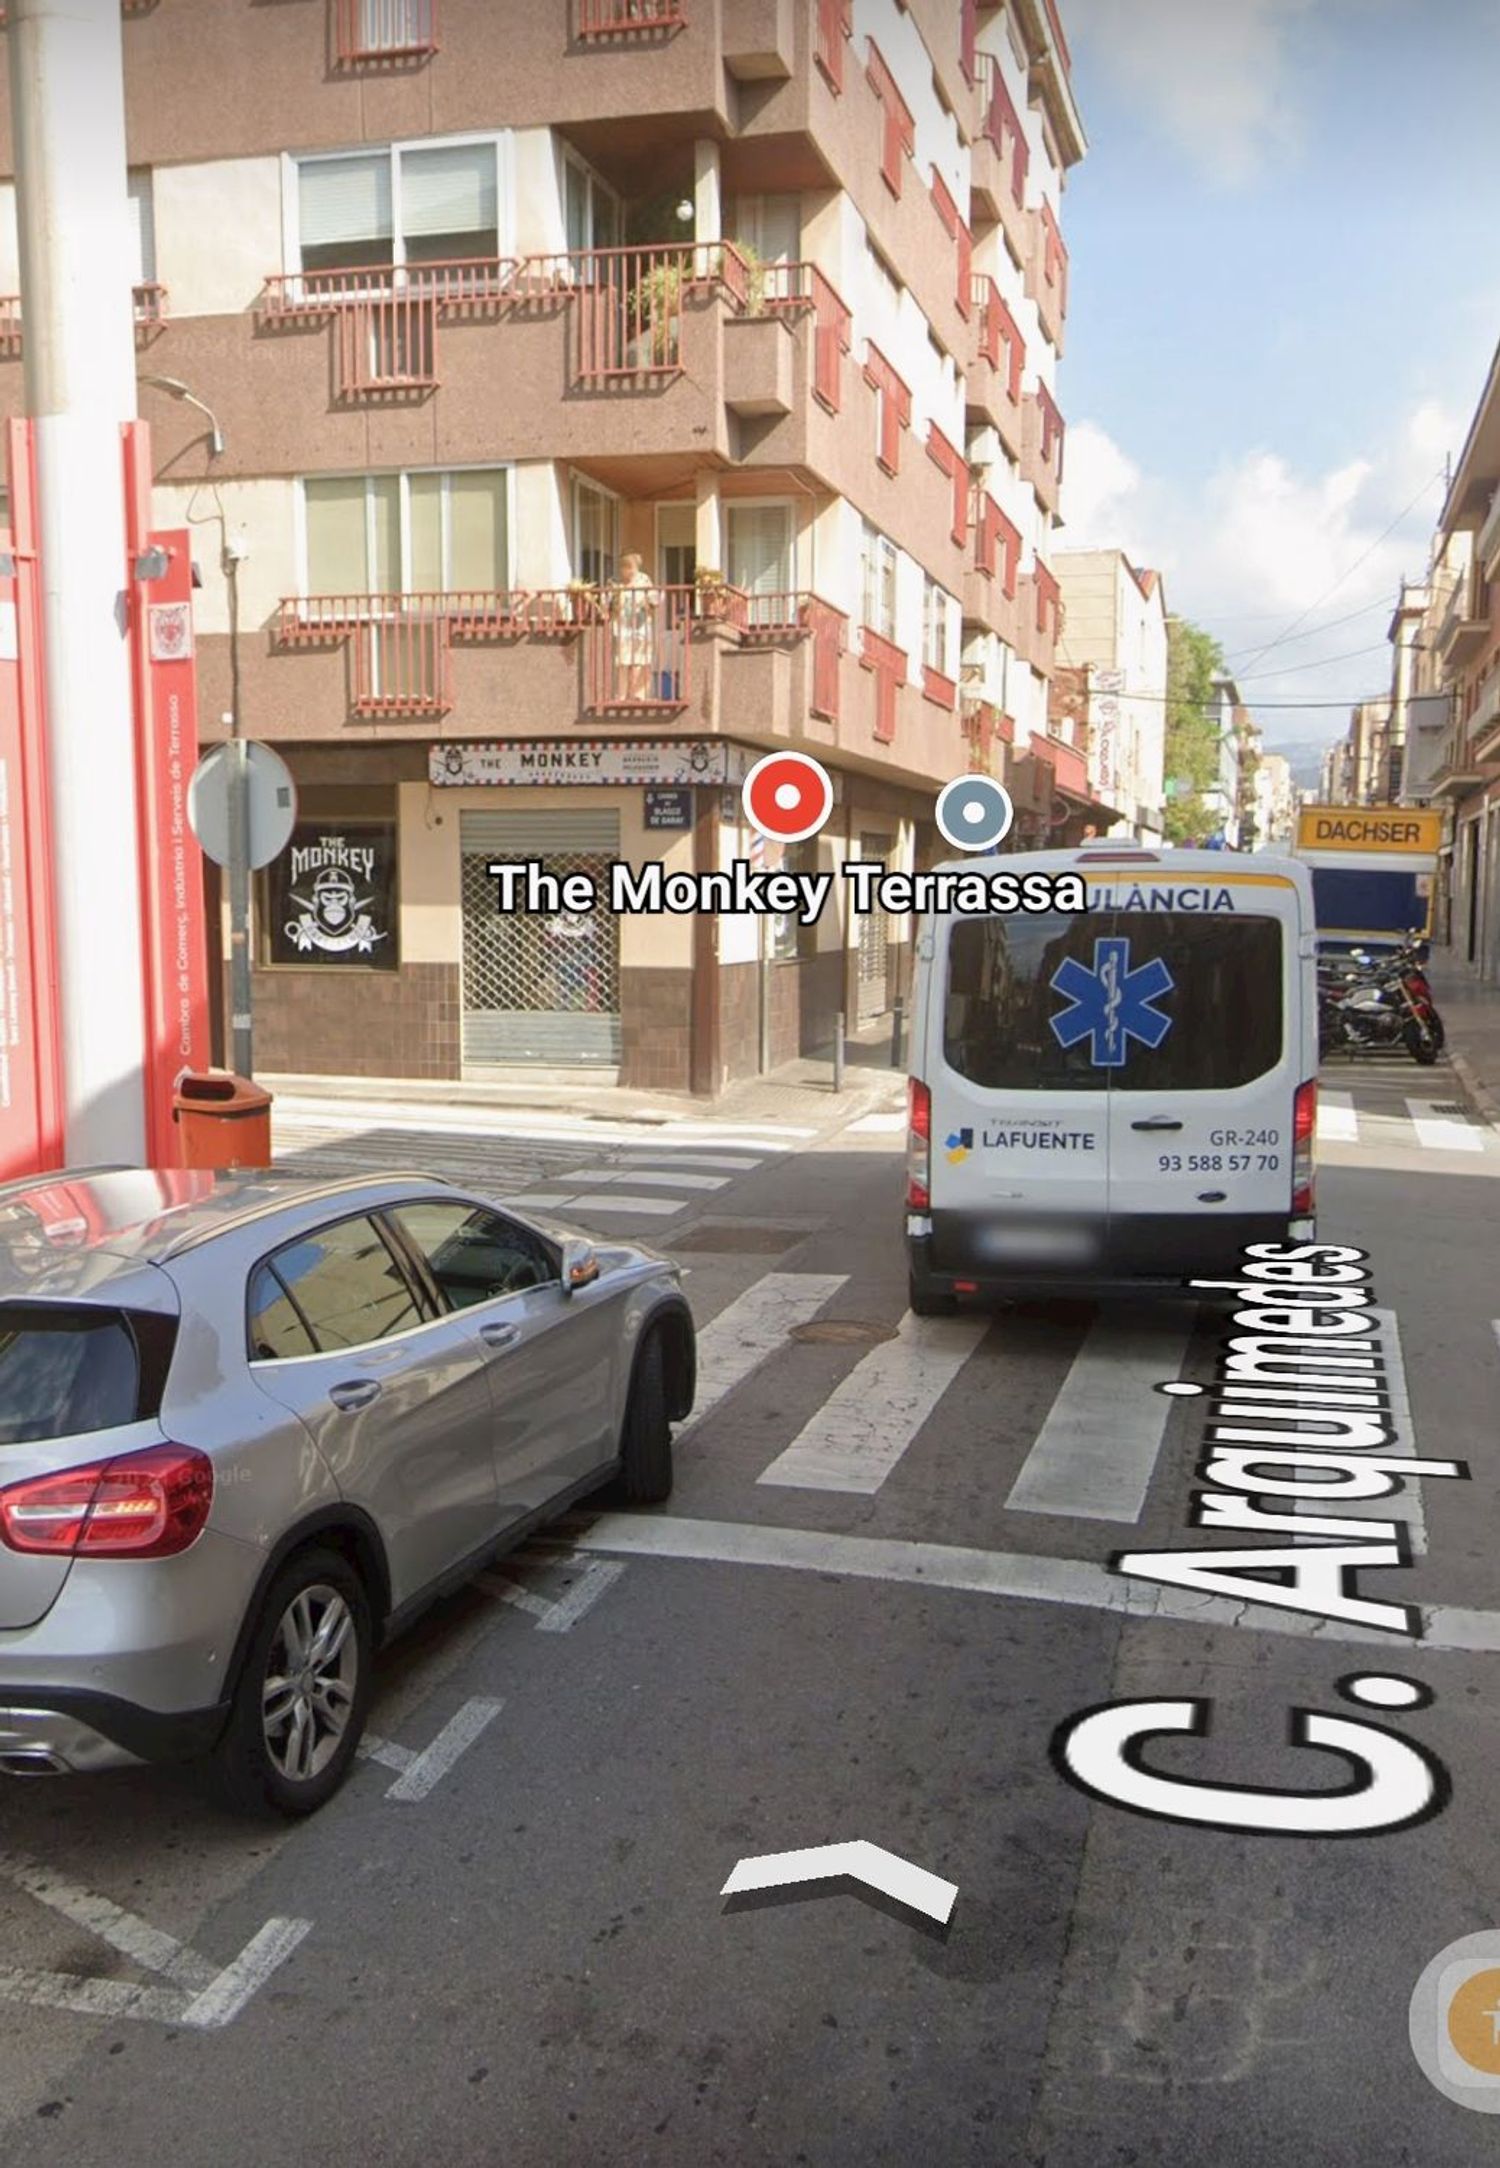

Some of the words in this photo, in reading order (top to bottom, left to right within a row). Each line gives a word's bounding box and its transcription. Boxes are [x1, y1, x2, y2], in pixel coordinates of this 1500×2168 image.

[169, 694, 181, 756] Terrassa
[170, 759, 182, 780] de
[480, 758, 502, 769] THE
[520, 752, 602, 768] MONKEY
[172, 782, 184, 836] Serveis
[319, 836, 346, 848] THE
[1316, 820, 1420, 843] DACHSER
[291, 847, 374, 886] MONKEY
[1086, 883, 1235, 912] ULÀNCIA
[178, 972, 190, 993] de
[179, 997, 192, 1056] Cambra
[983, 1130, 1096, 1150] LAFUENTE
[1210, 1129, 1279, 1147] GR-240
[1159, 1155, 1182, 1172] 93
[1188, 1155, 1223, 1171] 588
[1229, 1155, 1251, 1171] 57
[1257, 1154, 1279, 1171] 70
